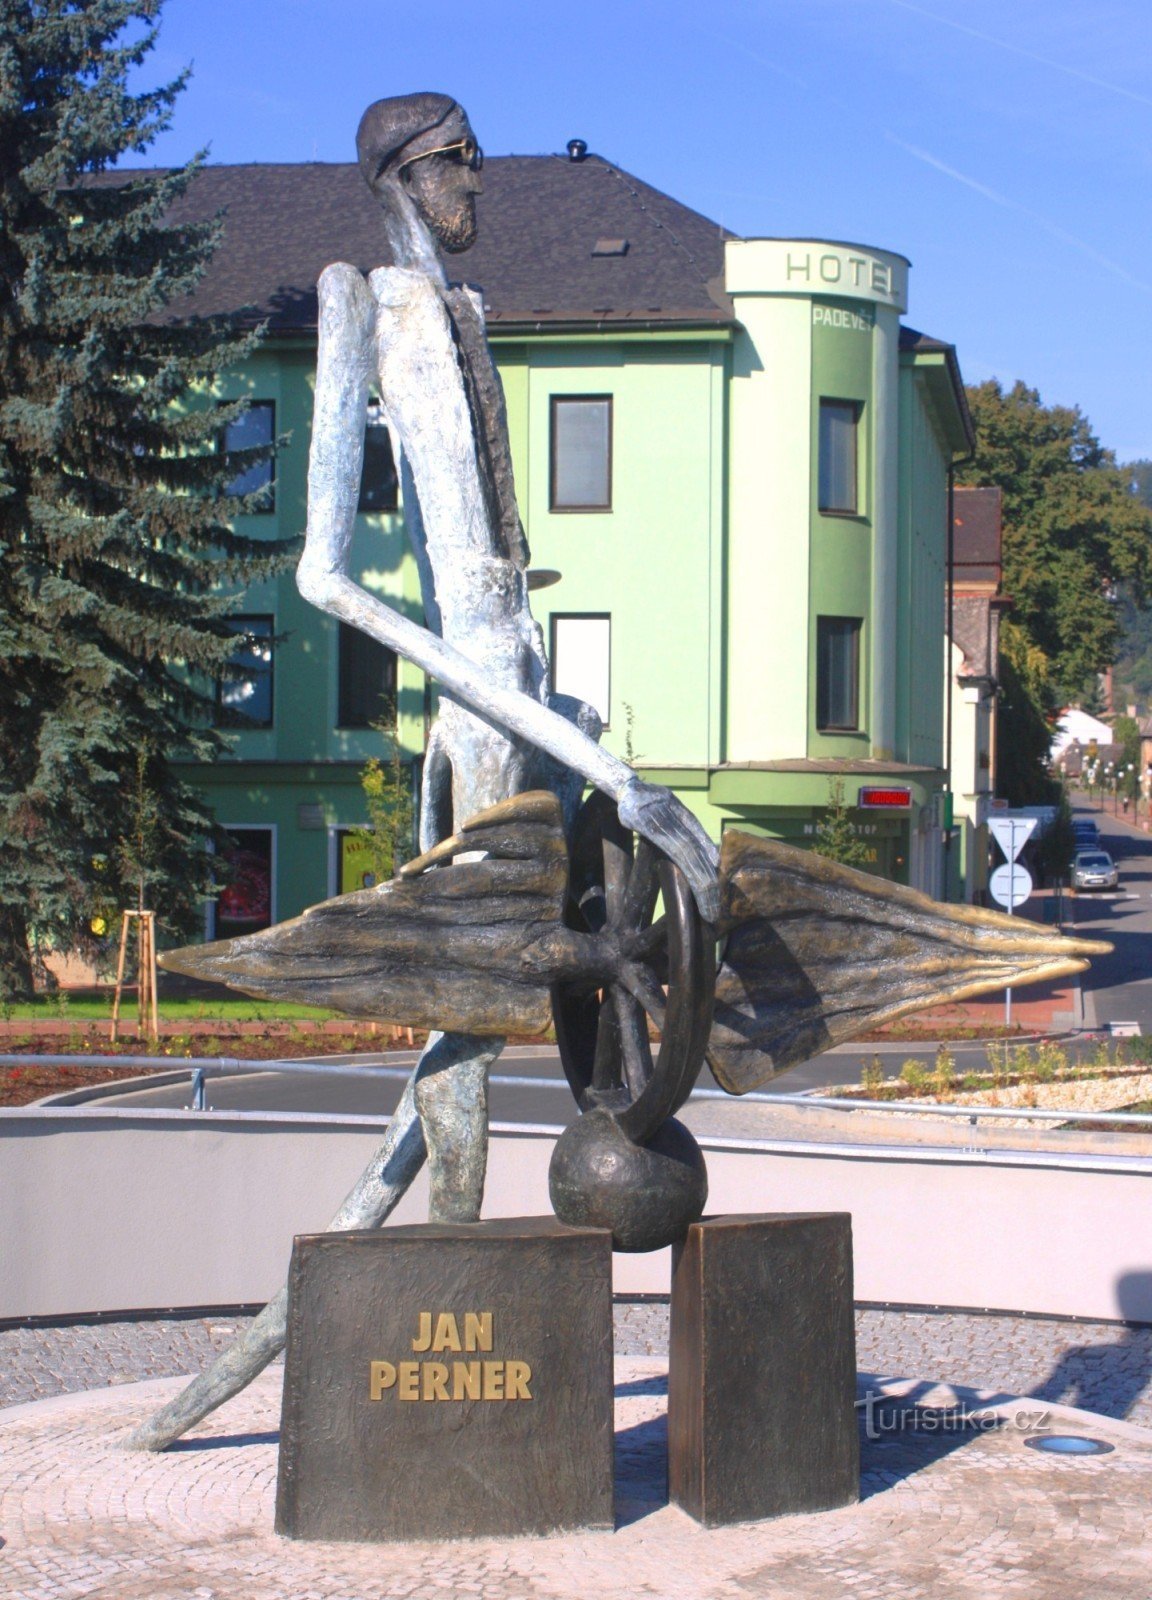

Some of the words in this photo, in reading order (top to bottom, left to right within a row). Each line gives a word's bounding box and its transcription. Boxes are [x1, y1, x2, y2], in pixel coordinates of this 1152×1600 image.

[786, 253, 899, 296] HOTEL
[412, 1312, 493, 1351] JAN
[370, 1361, 533, 1401] PERNER
